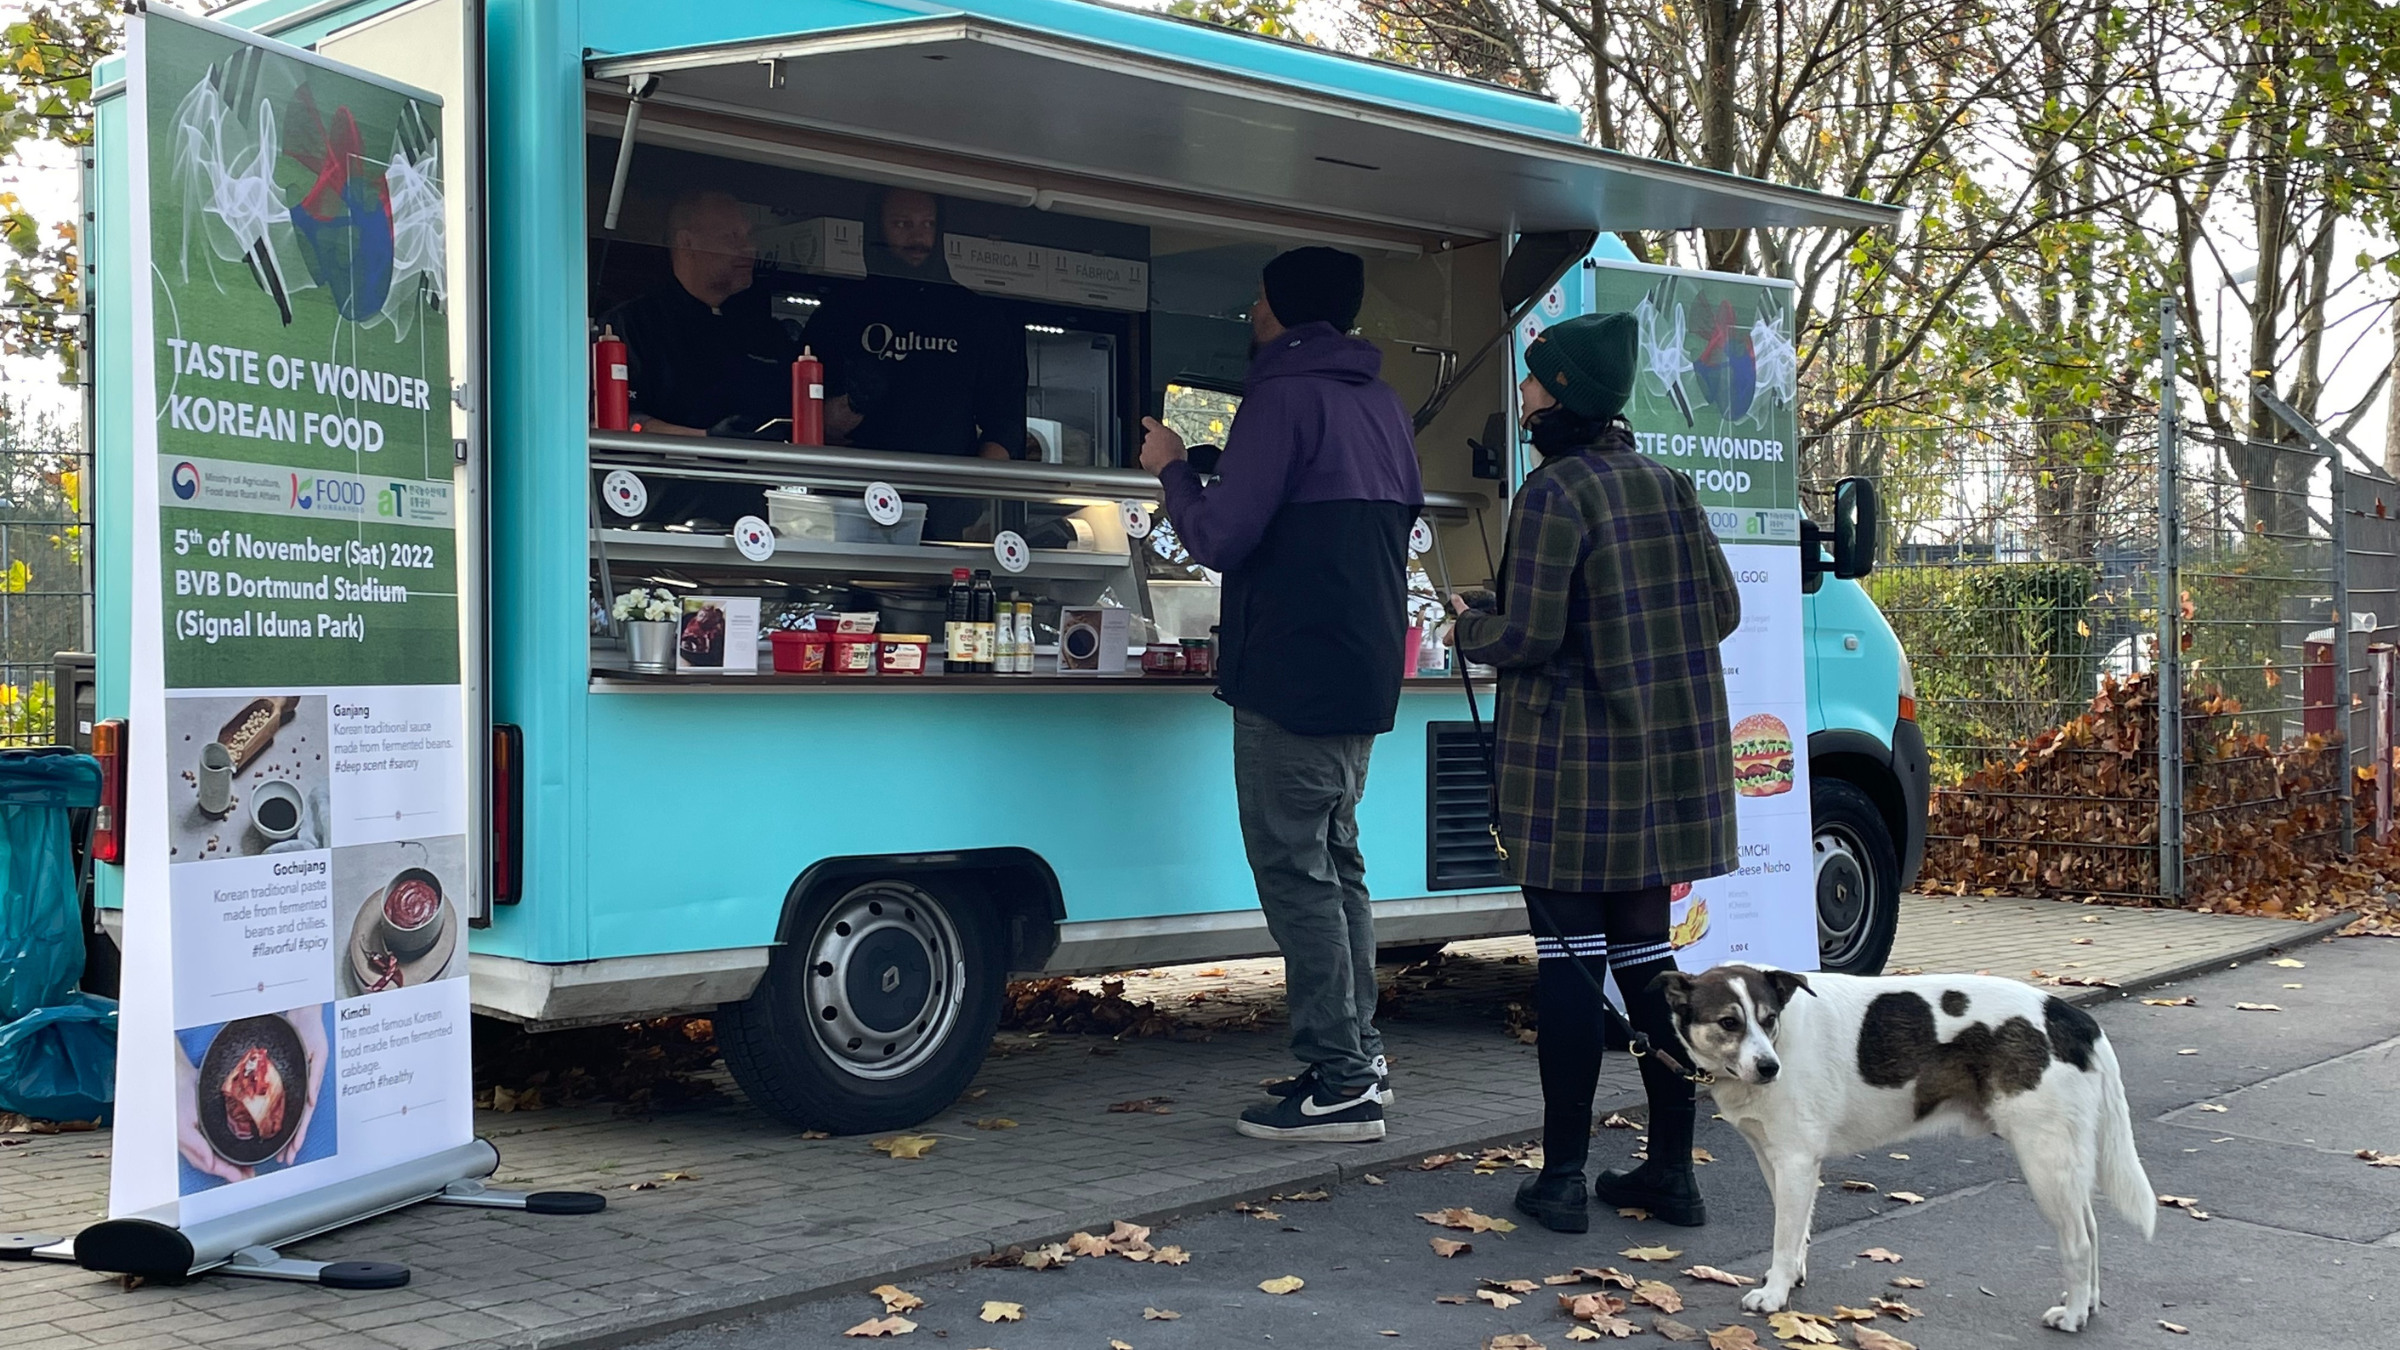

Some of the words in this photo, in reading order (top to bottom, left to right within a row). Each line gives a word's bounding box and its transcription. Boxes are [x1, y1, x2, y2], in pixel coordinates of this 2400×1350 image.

[861, 322, 958, 361] Qulture
[167, 338, 259, 385] TASTE
[266, 354, 304, 391] OF
[311, 361, 430, 411] WONDER
[170, 394, 296, 443] KOREAN
[304, 412, 384, 452] FOOD
[1634, 431, 1668, 455] STE
[1671, 433, 1697, 457] OF
[1700, 436, 1784, 462] WONDER
[205, 473, 232, 485] Ministry
[233, 476, 241, 484] of
[242, 476, 281, 489] Agriculture,
[316, 479, 365, 505] FOOD
[1696, 469, 1750, 493] FOOD
[205, 486, 224, 496] Food
[225, 489, 238, 497] and
[240, 489, 258, 499] Rural
[259, 492, 281, 501] Affairs
[377, 482, 407, 517] aT
[1707, 512, 1738, 528] OOD
[174, 528, 203, 555] 5th
[207, 530, 230, 557] of
[235, 533, 342, 563] November
[345, 540, 386, 570] (Sat)
[390, 543, 434, 569] 2022
[175, 569, 221, 596] BVB
[226, 571, 329, 600] Dortmund
[334, 576, 407, 603] Stadium
[1734, 571, 1768, 583] LGOGI
[176, 609, 251, 644] (Signal
[257, 611, 312, 638] Iduna
[317, 612, 365, 643] Park)
[333, 703, 370, 719] Ganjang
[334, 723, 362, 735] Korean
[364, 720, 408, 734] traditional
[409, 722, 431, 732] sauce
[334, 741, 358, 754] made
[359, 740, 380, 752] from
[382, 737, 424, 752] fermented
[425, 737, 454, 749] beans.
[335, 759, 361, 775] #deep
[362, 759, 387, 771] scent
[389, 757, 419, 771] #savory
[273, 860, 326, 876] Gochujang
[1763, 860, 1791, 873] Nacho
[213, 889, 249, 903] Korean
[250, 880, 299, 898] traditional
[301, 879, 327, 895] paste
[223, 906, 252, 921] made
[253, 904, 277, 918] from
[279, 895, 327, 915] fermented
[244, 925, 275, 939] beans
[276, 919, 295, 935] and
[252, 938, 297, 958] #flavorful
[298, 935, 328, 952] #spicy
[340, 1003, 371, 1021] Kimchi
[340, 1027, 357, 1040] The
[358, 1022, 380, 1036] most
[381, 1017, 413, 1031] famous
[414, 1010, 442, 1024] Korean
[340, 1042, 361, 1059] food
[362, 1038, 388, 1054] made
[389, 1035, 410, 1048] from
[410, 1022, 453, 1042] fermented
[341, 1061, 381, 1079] cabbage.
[341, 1077, 375, 1097] #crunch
[377, 1068, 414, 1088] #healthy
